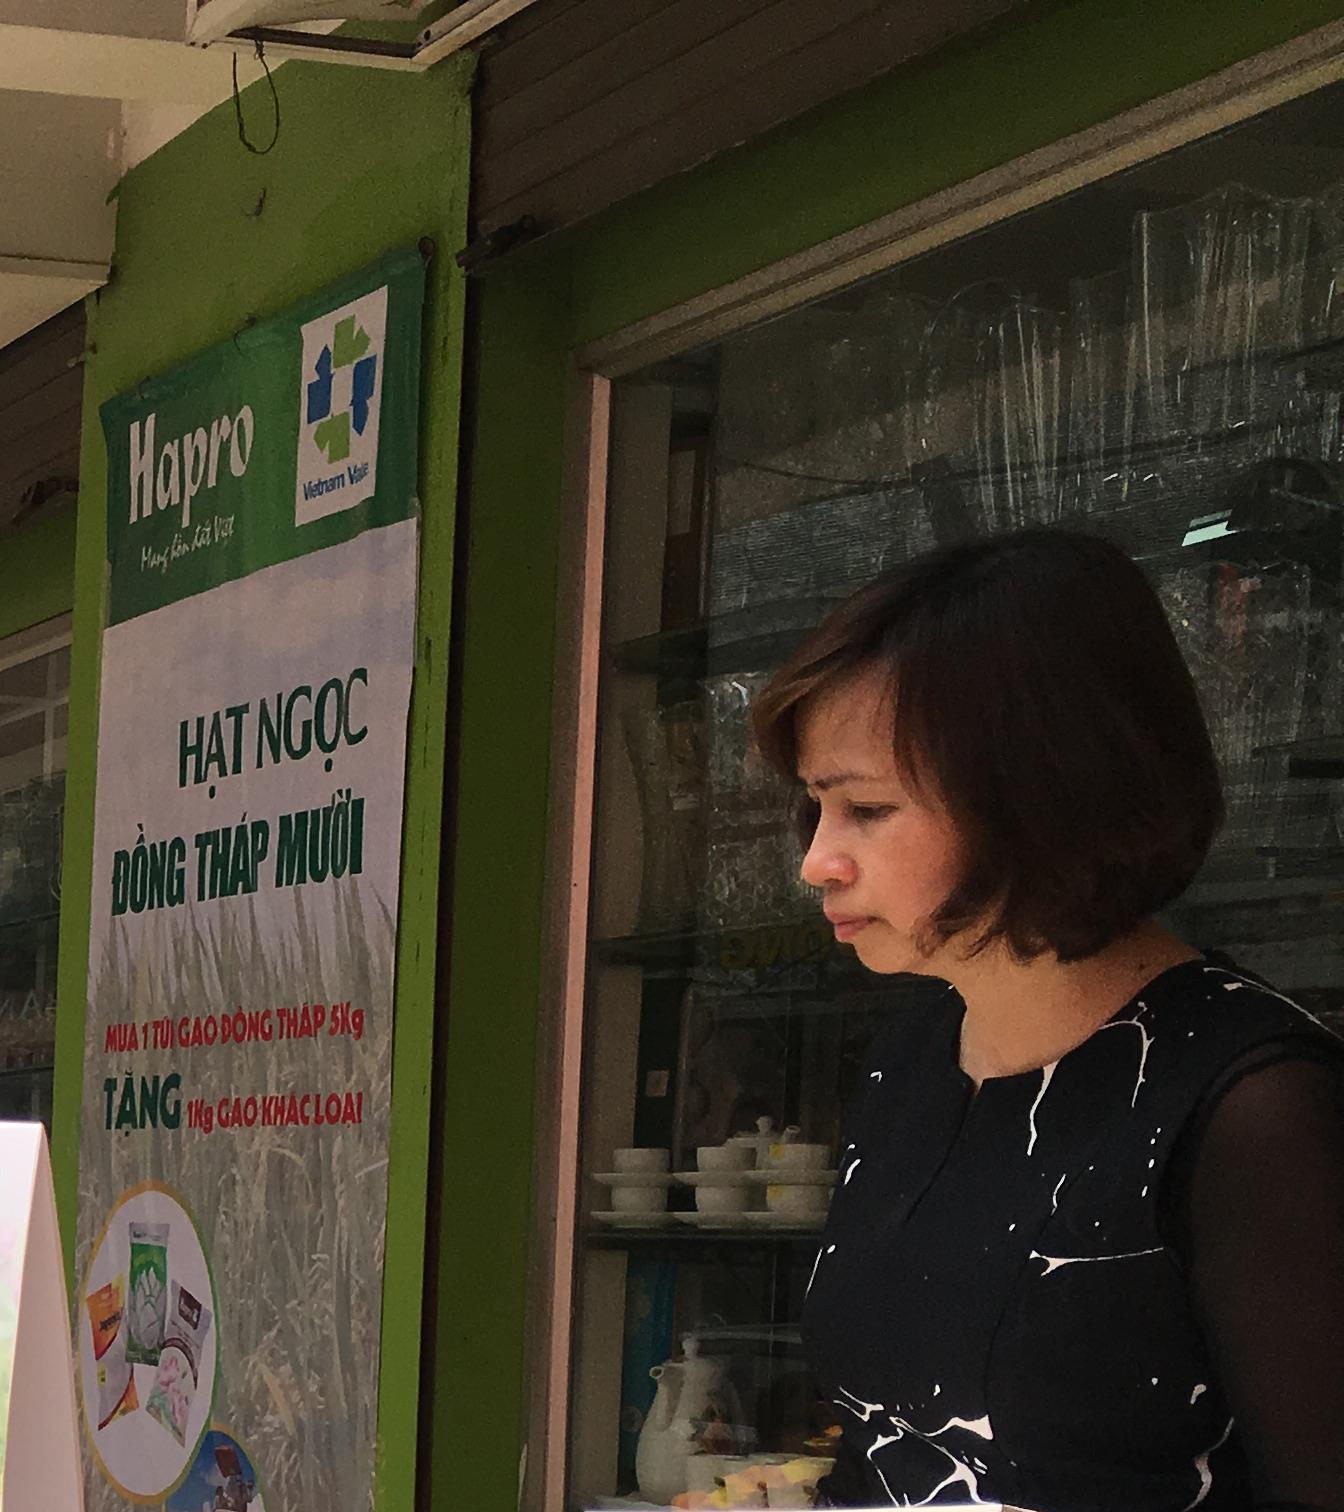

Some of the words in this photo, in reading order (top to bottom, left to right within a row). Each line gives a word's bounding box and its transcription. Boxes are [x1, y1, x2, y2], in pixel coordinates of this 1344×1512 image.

[128, 404, 255, 528] Hapro
[179, 703, 250, 799] HẠT
[255, 667, 369, 773] NGỌC
[111, 823, 187, 917] ĐỒNG
[195, 811, 269, 902] THÁP
[275, 788, 365, 888] MƯỜI
[105, 1022, 139, 1052] MUA
[142, 1020, 148, 1050] 1
[221, 1006, 273, 1045] ĐỒNG
[277, 1001, 326, 1040] THÁP
[104, 1069, 181, 1137] TẶNG
[188, 1099, 213, 1134] 1Kg
[315, 1090, 363, 1128] LOẠI
